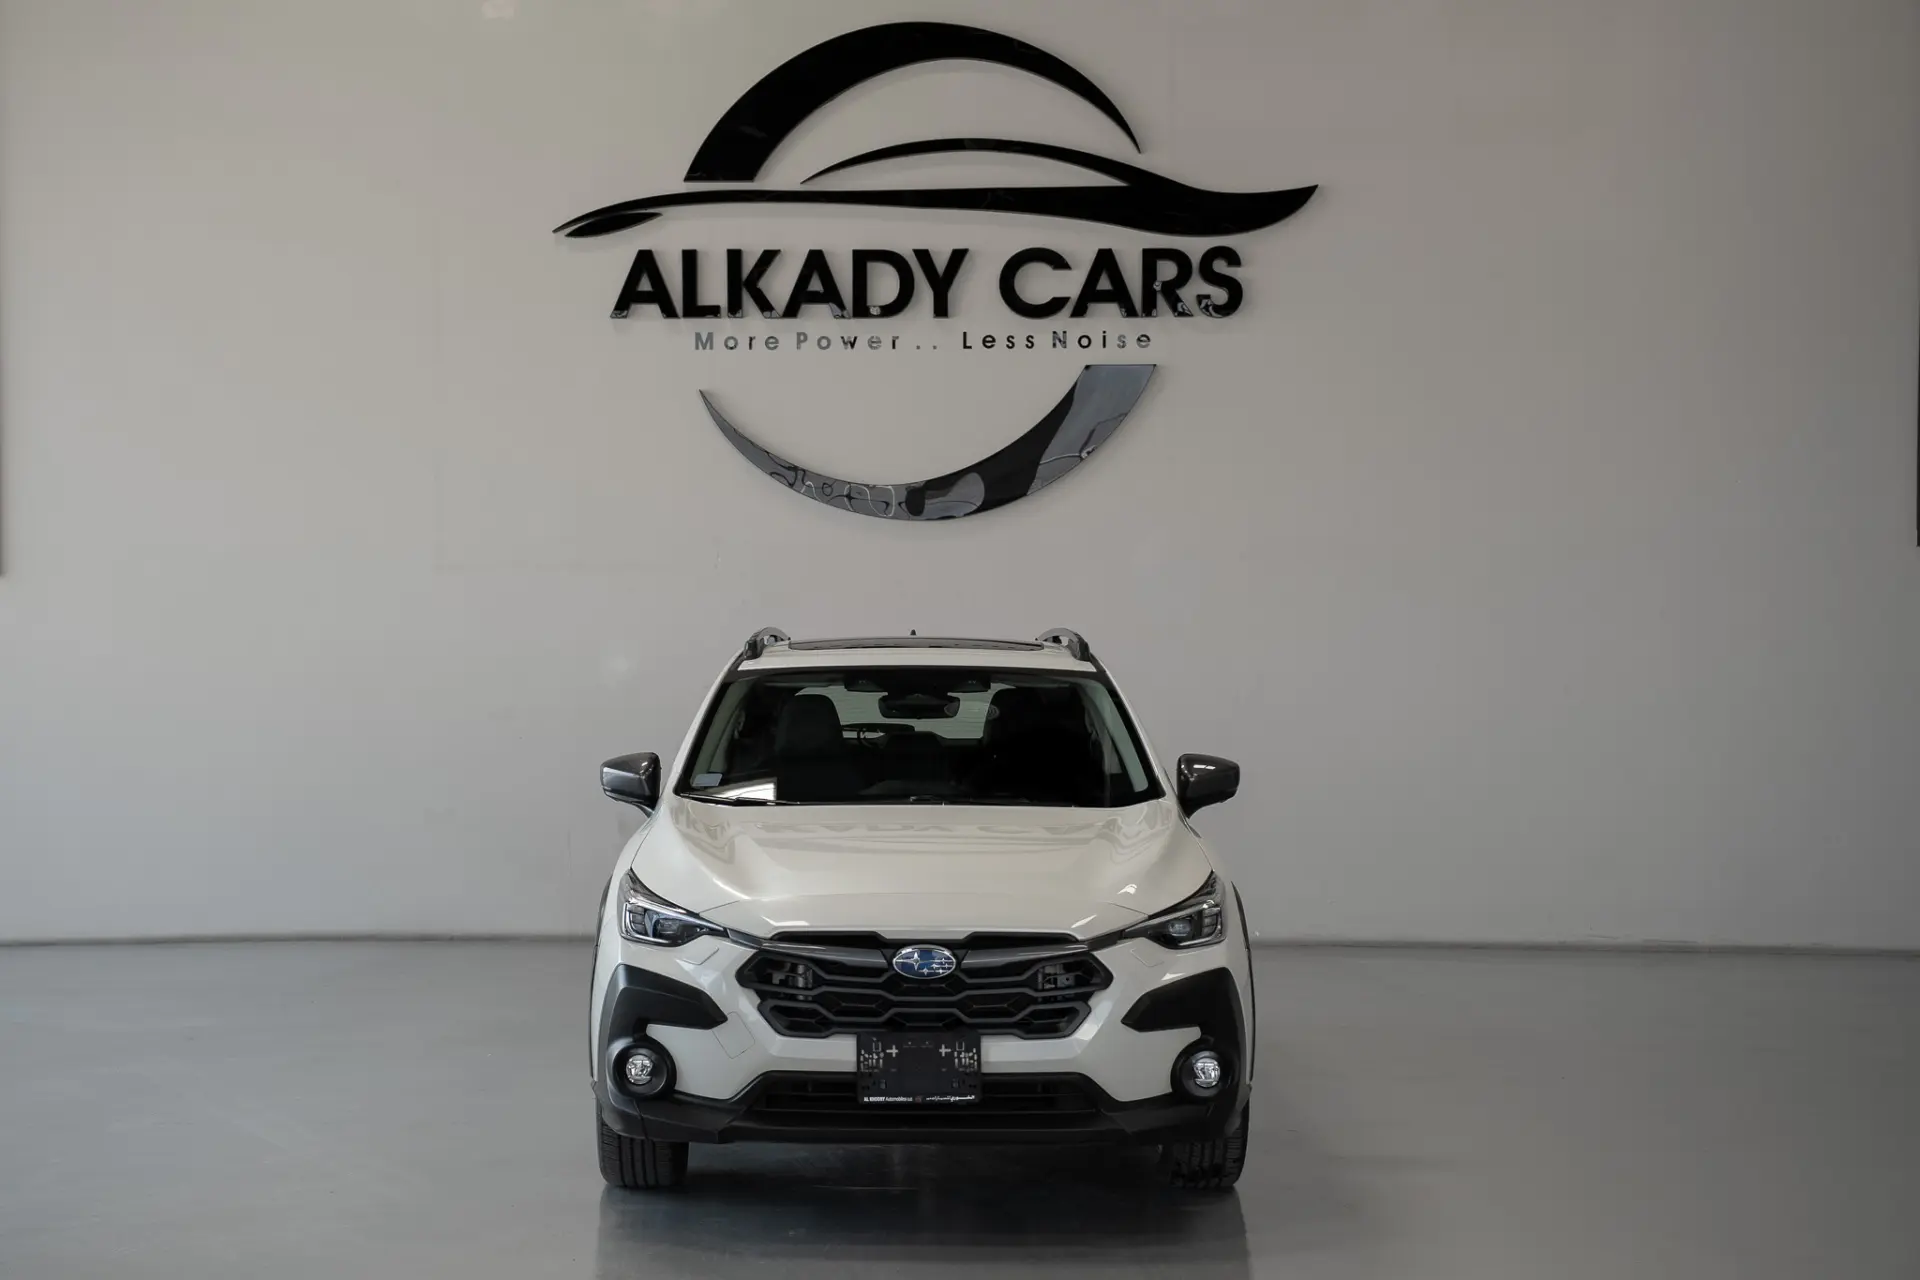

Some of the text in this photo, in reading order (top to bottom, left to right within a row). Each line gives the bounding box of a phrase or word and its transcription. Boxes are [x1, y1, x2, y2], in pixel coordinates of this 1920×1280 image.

[610, 246, 1243, 319] ALKADY CARS
[695, 332, 779, 350] More
[963, 331, 1034, 349] Less
[1052, 330, 1151, 349] Noise
